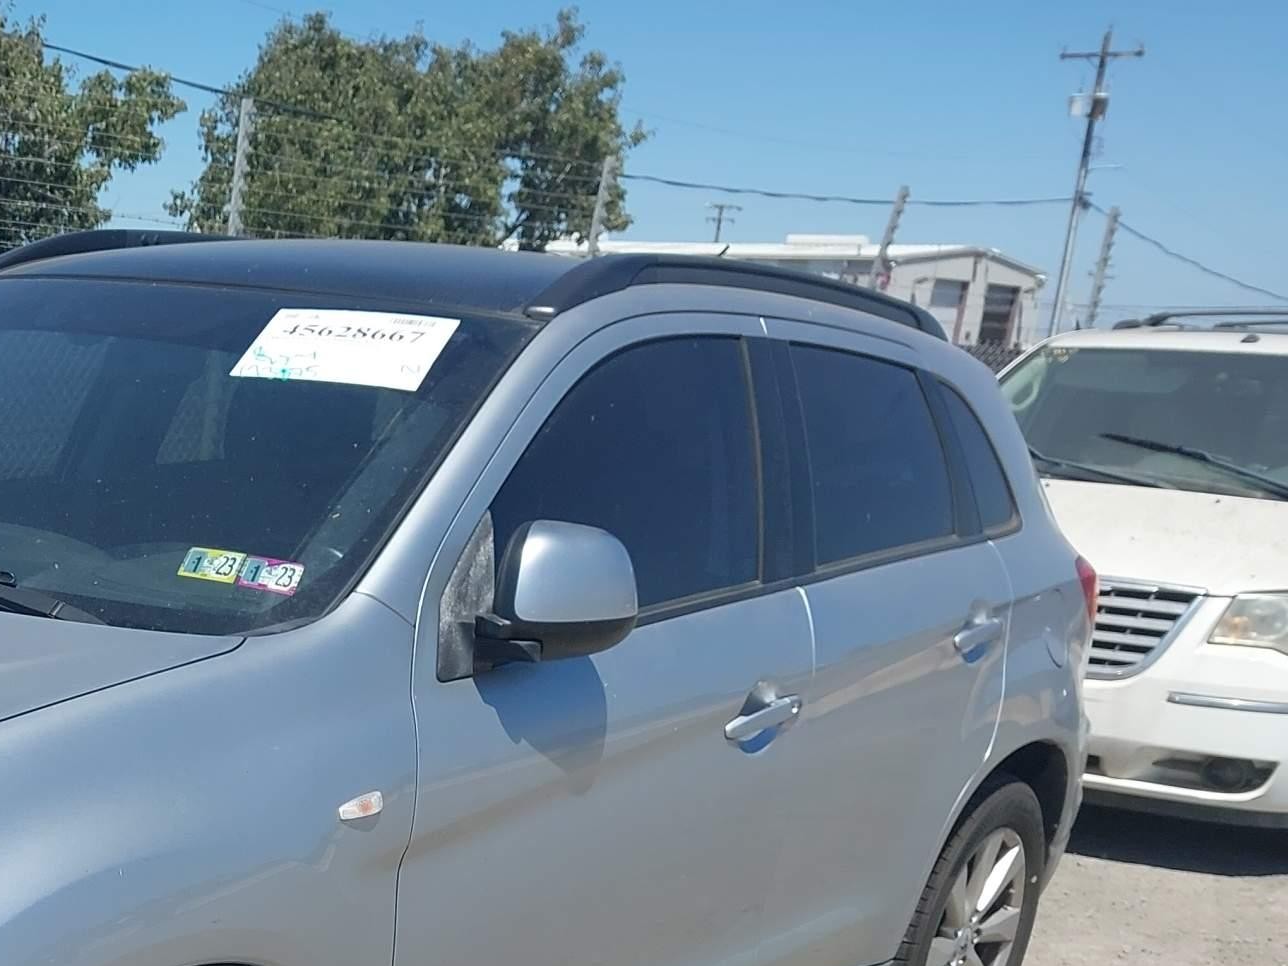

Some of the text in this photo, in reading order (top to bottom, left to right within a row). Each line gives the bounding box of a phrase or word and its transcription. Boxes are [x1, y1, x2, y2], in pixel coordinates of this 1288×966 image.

[283, 324, 427, 344] 45628667
[216, 556, 237, 576] 23
[275, 567, 297, 587] 23
